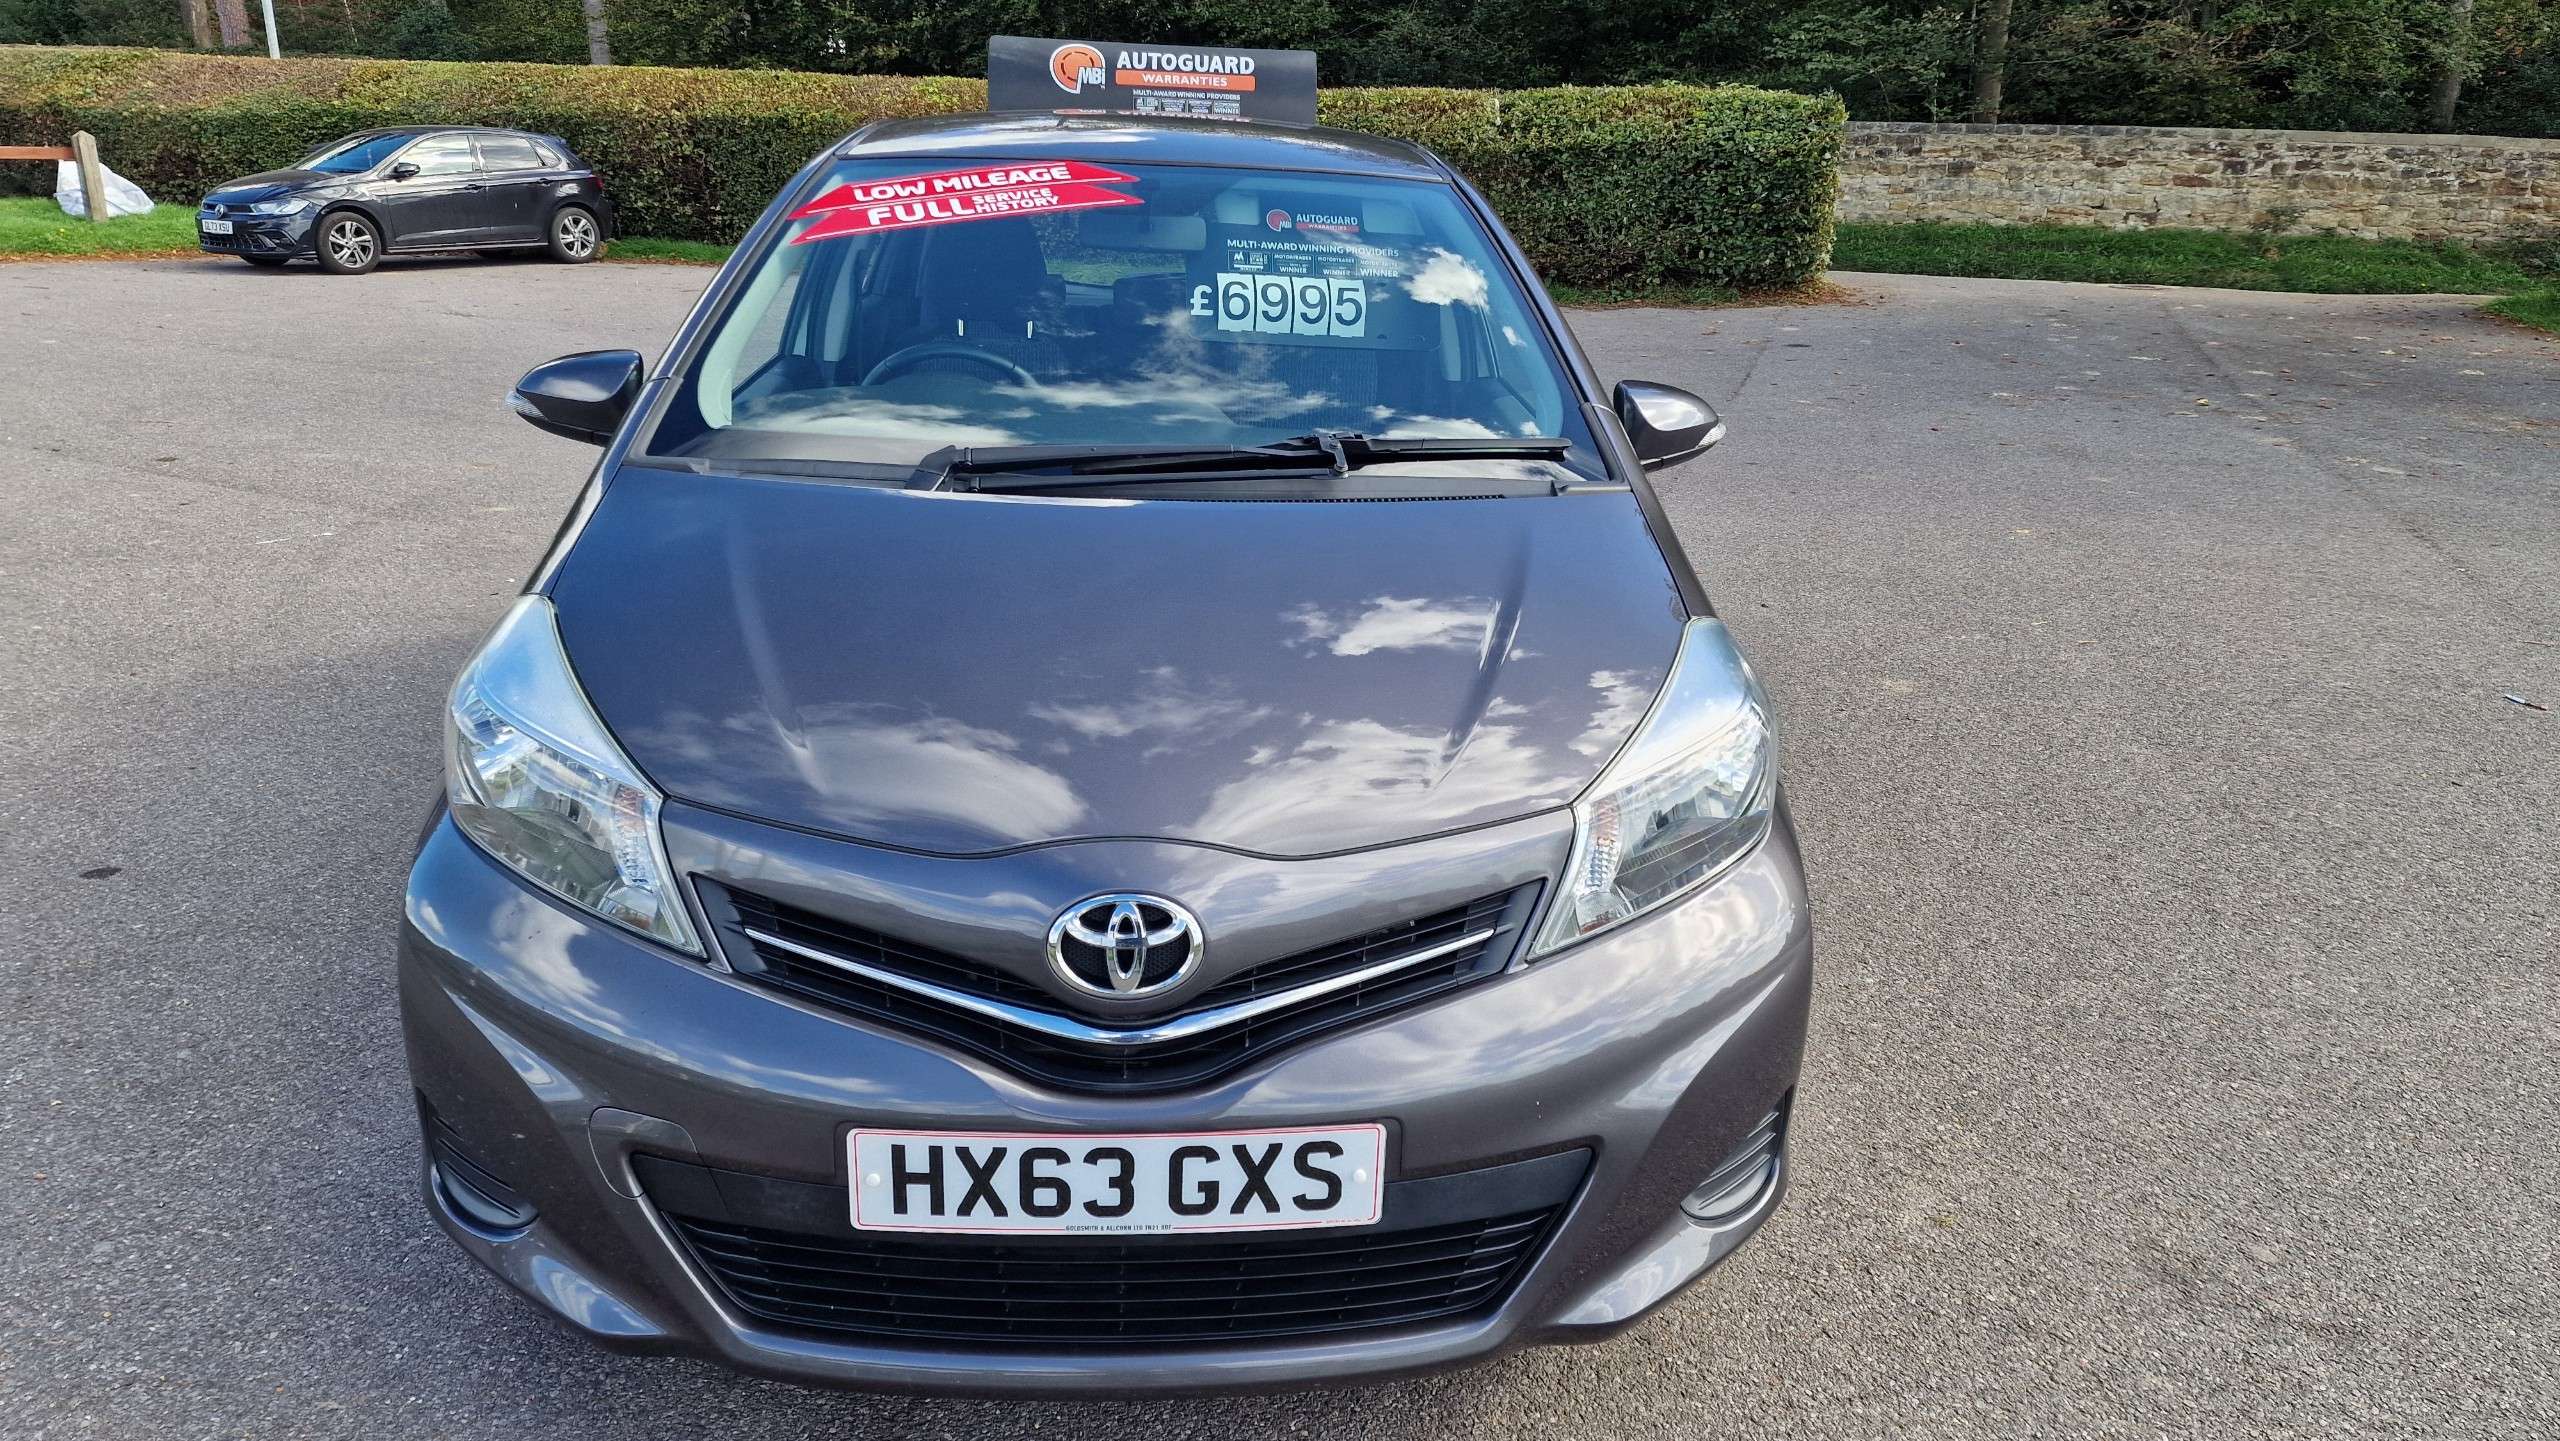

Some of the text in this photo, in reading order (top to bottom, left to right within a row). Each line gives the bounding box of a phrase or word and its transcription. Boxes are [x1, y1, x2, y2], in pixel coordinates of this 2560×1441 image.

[1116, 51, 1255, 74] AUTOGUARD
[1142, 73, 1228, 87] WARRANTIES
[1177, 91, 1206, 99] WINNING
[1206, 93, 1241, 101] PROVIDERS
[854, 165, 1071, 202] LOW MILEAGE
[972, 187, 1053, 205] SERVICE
[977, 195, 1059, 214] HISTORY
[867, 196, 977, 225] FULL
[1296, 213, 1359, 225] AUTOGUARD
[1298, 243, 1344, 254] WINNING
[1345, 247, 1399, 257] PROVIDERS
[1360, 267, 1400, 278] WINNER
[890, 1140, 1344, 1218] HX63 GXS
